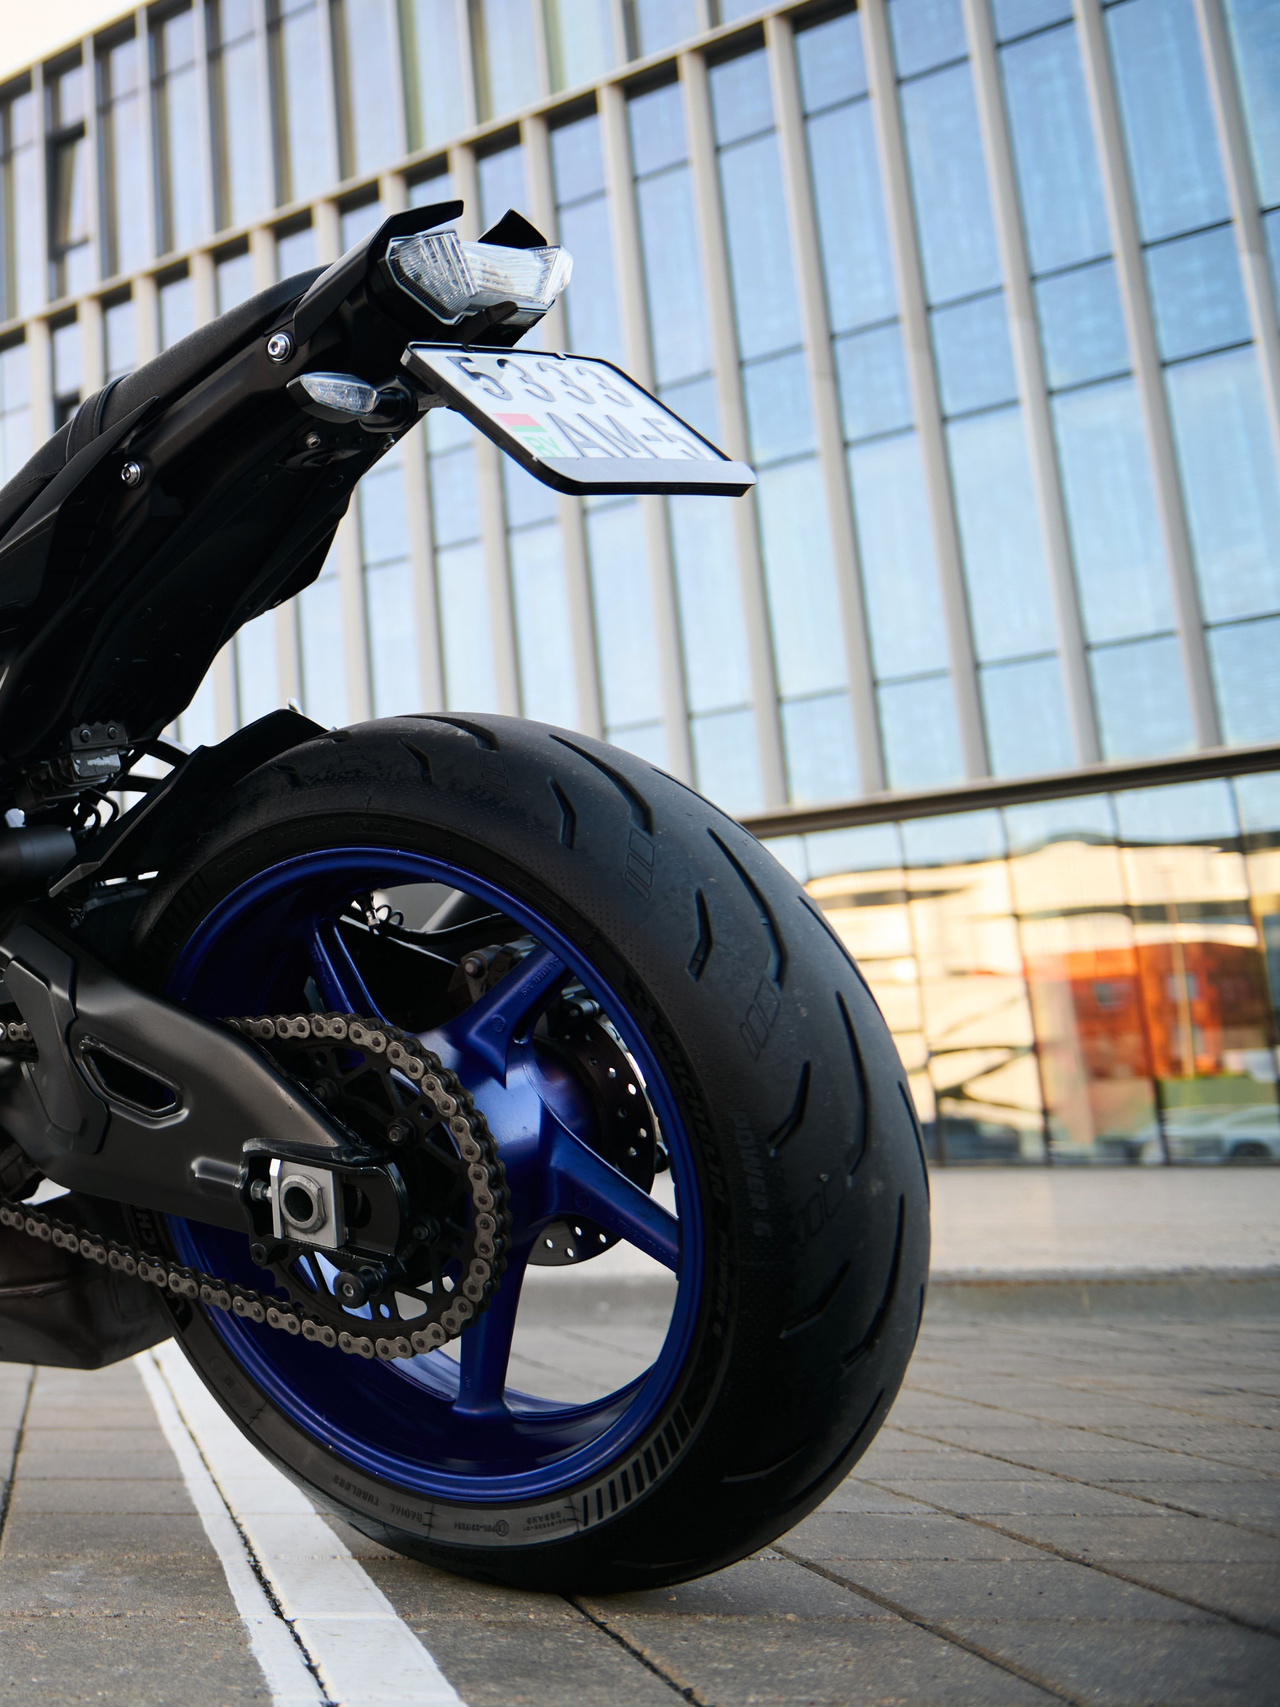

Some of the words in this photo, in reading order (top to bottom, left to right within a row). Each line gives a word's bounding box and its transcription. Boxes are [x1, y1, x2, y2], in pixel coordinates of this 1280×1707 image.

[446, 355, 634, 407] 5333
[546, 412, 711, 460] AM-5
[728, 1110, 769, 1211] POWER
[752, 1221, 773, 1238] 6
[333, 1474, 380, 1507] TUBELESS
